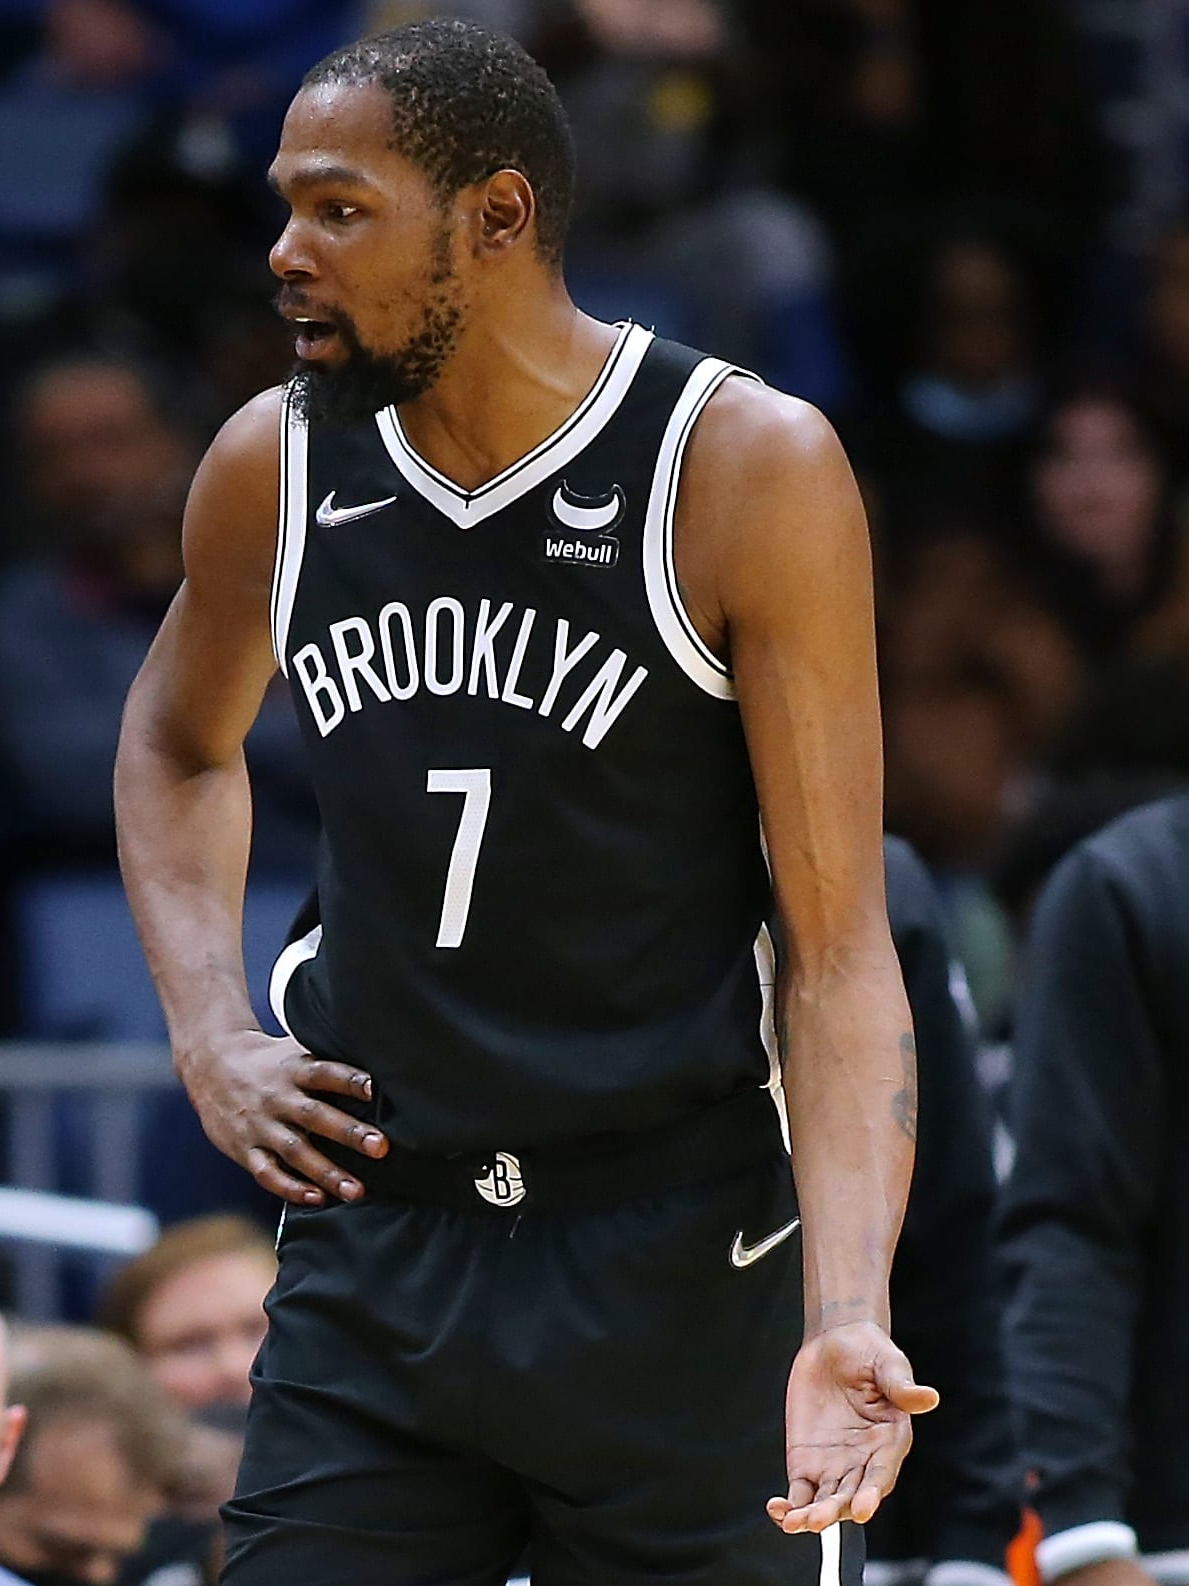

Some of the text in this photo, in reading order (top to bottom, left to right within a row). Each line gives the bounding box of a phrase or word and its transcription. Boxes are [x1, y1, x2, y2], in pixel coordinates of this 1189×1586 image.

[546, 538, 612, 564] Webull
[292, 596, 649, 751] BROOKLYN
[426, 768, 492, 949] 7
